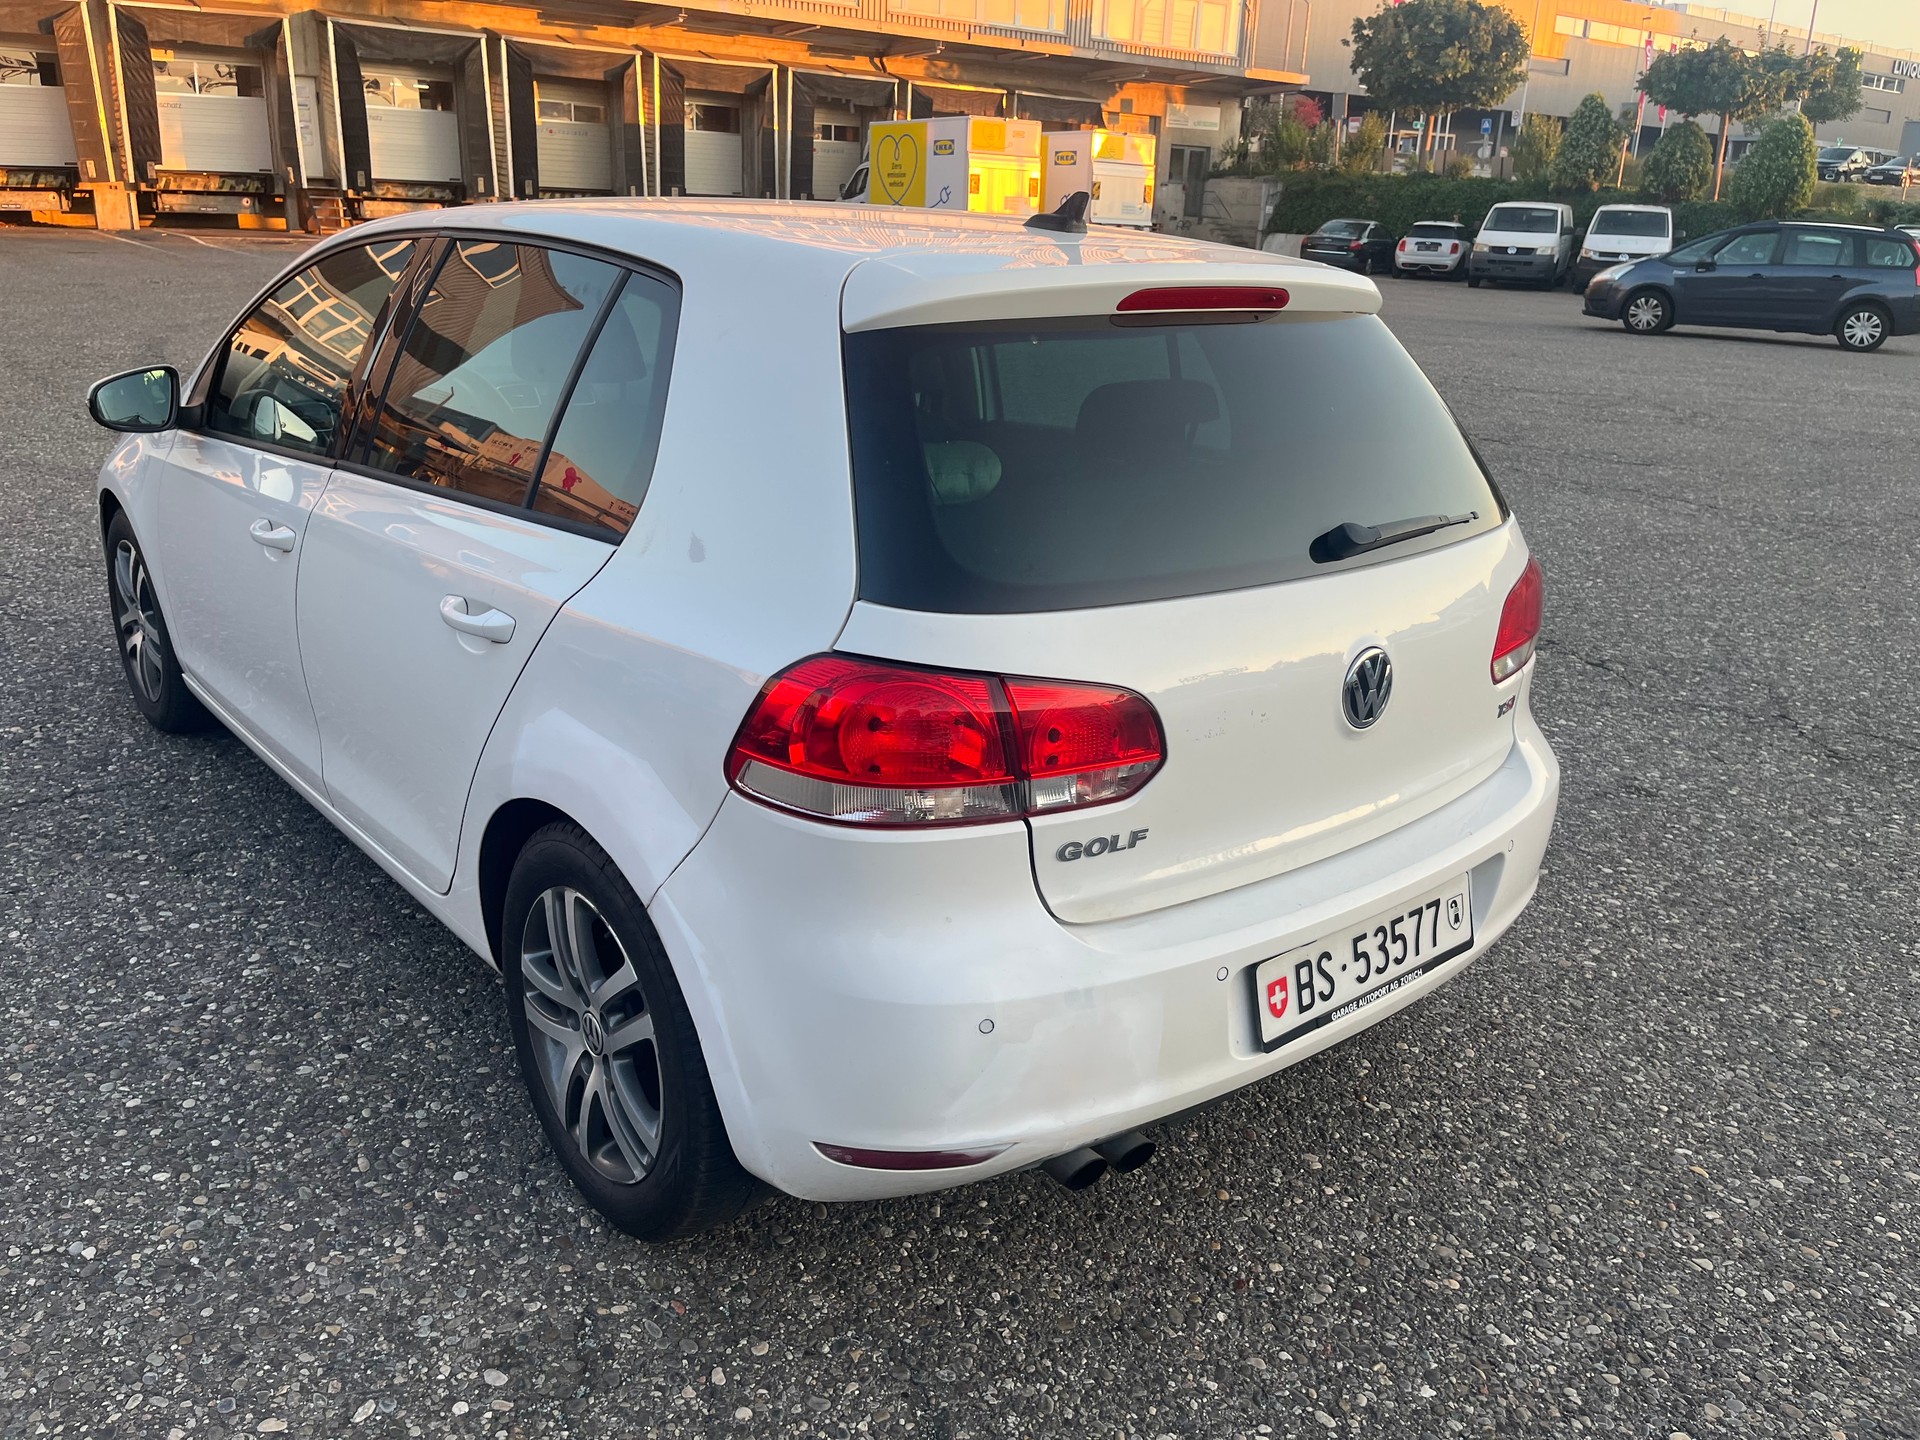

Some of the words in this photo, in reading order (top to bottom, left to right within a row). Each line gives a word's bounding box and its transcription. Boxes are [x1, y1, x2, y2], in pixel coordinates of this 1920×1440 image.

[935, 143, 953, 151] IKEA
[1056, 154, 1075, 162] IKEA
[1055, 827, 1150, 862] GOLF
[1331, 1001, 1358, 1021] GARAGE
[1358, 986, 1389, 1008] AUTOPORT
[1389, 980, 1399, 991] AG
[1400, 968, 1423, 986] ZÜRICH
